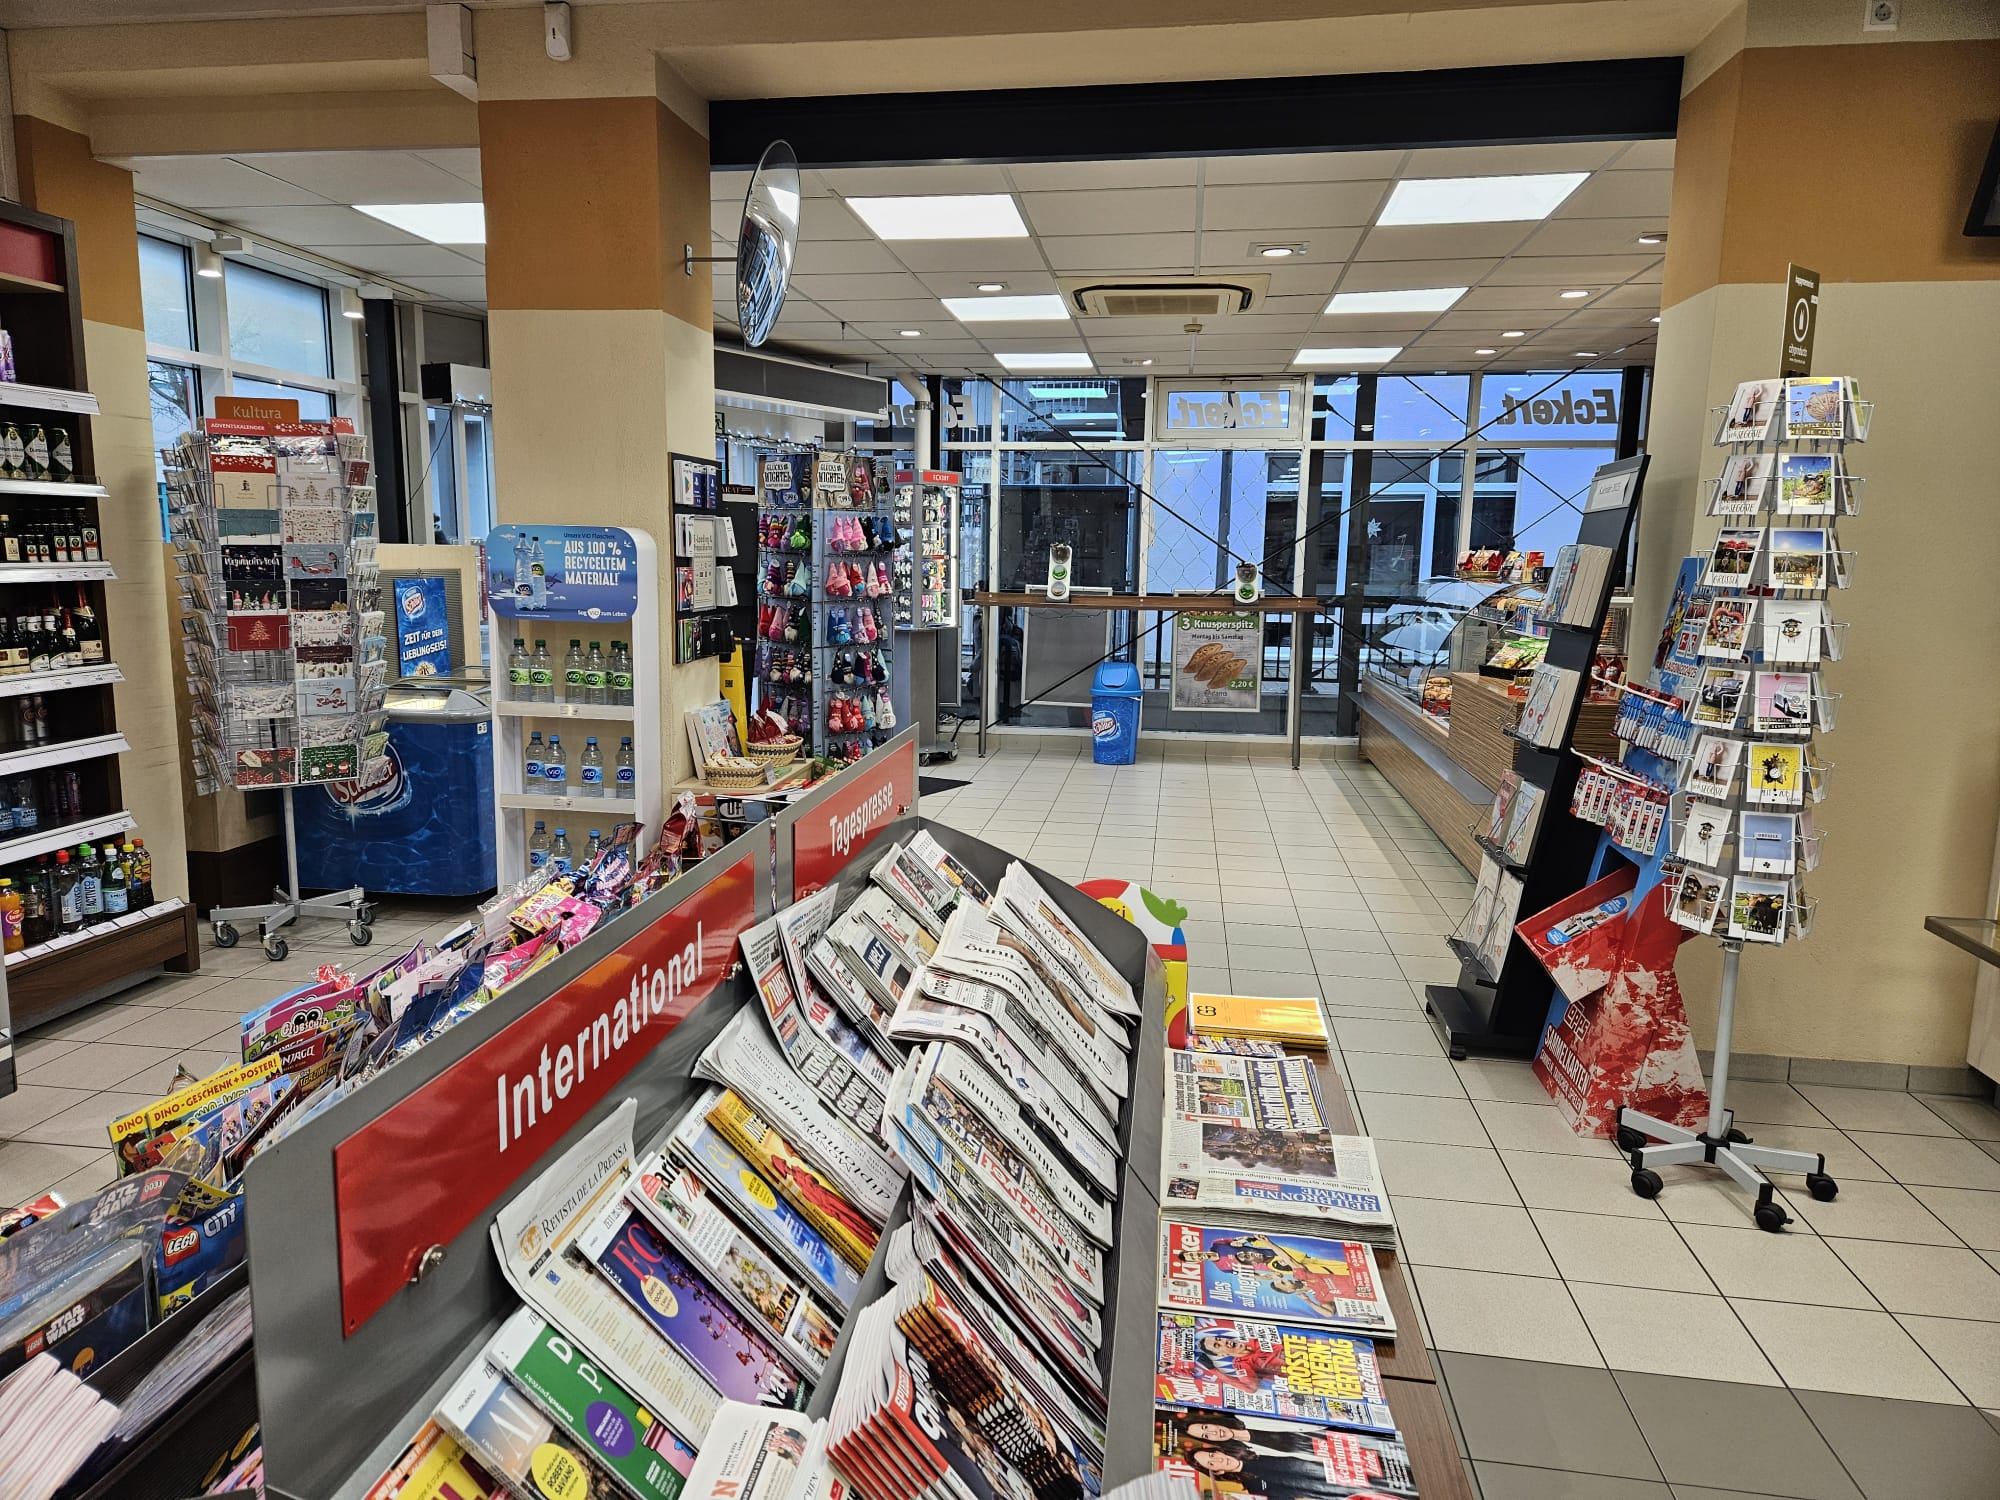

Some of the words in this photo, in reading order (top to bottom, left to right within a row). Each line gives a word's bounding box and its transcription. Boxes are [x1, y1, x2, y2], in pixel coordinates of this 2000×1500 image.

[233, 406, 281, 419] Kultura
[211, 423, 265, 431] ADVENTSKALENDER
[564, 541, 584, 554] AUS
[587, 542, 605, 555] 100
[607, 542, 621, 555] %
[565, 556, 626, 571] RECYCELTEM
[404, 630, 420, 645] ZEIT
[422, 631, 431, 641] FÜR
[1182, 618, 1190, 629] 3
[1194, 620, 1254, 631] Knusperspitz
[403, 640, 447, 661] LIEBLINGSEIS!
[830, 780, 894, 856] Tagespresse
[498, 920, 704, 1153] International
[240, 1059, 277, 1083] POSTER!
[1256, 1061, 1278, 1073] der
[1544, 1026, 1591, 1093] SAMMELKARTEN
[1260, 1073, 1280, 1087] uns
[954, 1066, 1008, 1124] Zeitung
[1261, 1087, 1283, 1102] trifft
[1283, 1059, 1317, 1128] Gebühren-Hammer
[1035, 1097, 1072, 1139] DIE
[1262, 1103, 1286, 1117] hart
[1264, 1118, 1290, 1130] So
[764, 1083, 891, 1202] diplomatique
[1010, 1123, 1061, 1184] Zürcher
[542, 1197, 578, 1237] REVISTA
[577, 1186, 588, 1205] DE
[587, 1176, 599, 1193] LA
[597, 1143, 629, 1176] PRENSA
[1239, 1186, 1378, 1211] HEILBRONNER
[1299, 1185, 1376, 1204] STIMME
[1059, 1182, 1099, 1225] Neue
[203, 1204, 236, 1238] CITY
[166, 1232, 198, 1256] LEGO
[1174, 1225, 1203, 1281] kiker
[1209, 1281, 1234, 1302] Alles
[1232, 1263, 1258, 1296] Angriff
[1240, 1295, 1255, 1307] auf
[46, 1314, 84, 1344] WARS
[49, 1304, 85, 1328] STAR
[27, 1336, 44, 1356] LEGO
[1180, 1331, 1195, 1361] Weltstars
[1267, 1326, 1281, 1343] Paket
[1277, 1333, 1316, 1394] GRÖSSTE
[1305, 1338, 1343, 1397] BAYERN-
[1329, 1338, 1368, 1401] VERTRAG
[1356, 1352, 1380, 1383] Zeiten
[1168, 1376, 1205, 1402] Sport
[1201, 1382, 1219, 1396] Bild
[1272, 1374, 1289, 1391] Der
[1360, 1382, 1383, 1404] aller
[543, 1392, 577, 1423] Deutsch
[1315, 1438, 1331, 1458] Das
[1331, 1433, 1350, 1483] Geheimnis
[1342, 1434, 1362, 1463] neuen
[542, 1456, 572, 1489] ROBERTO
[1362, 1450, 1383, 1476] Liebe
[550, 1463, 579, 1495] SAVIANO
